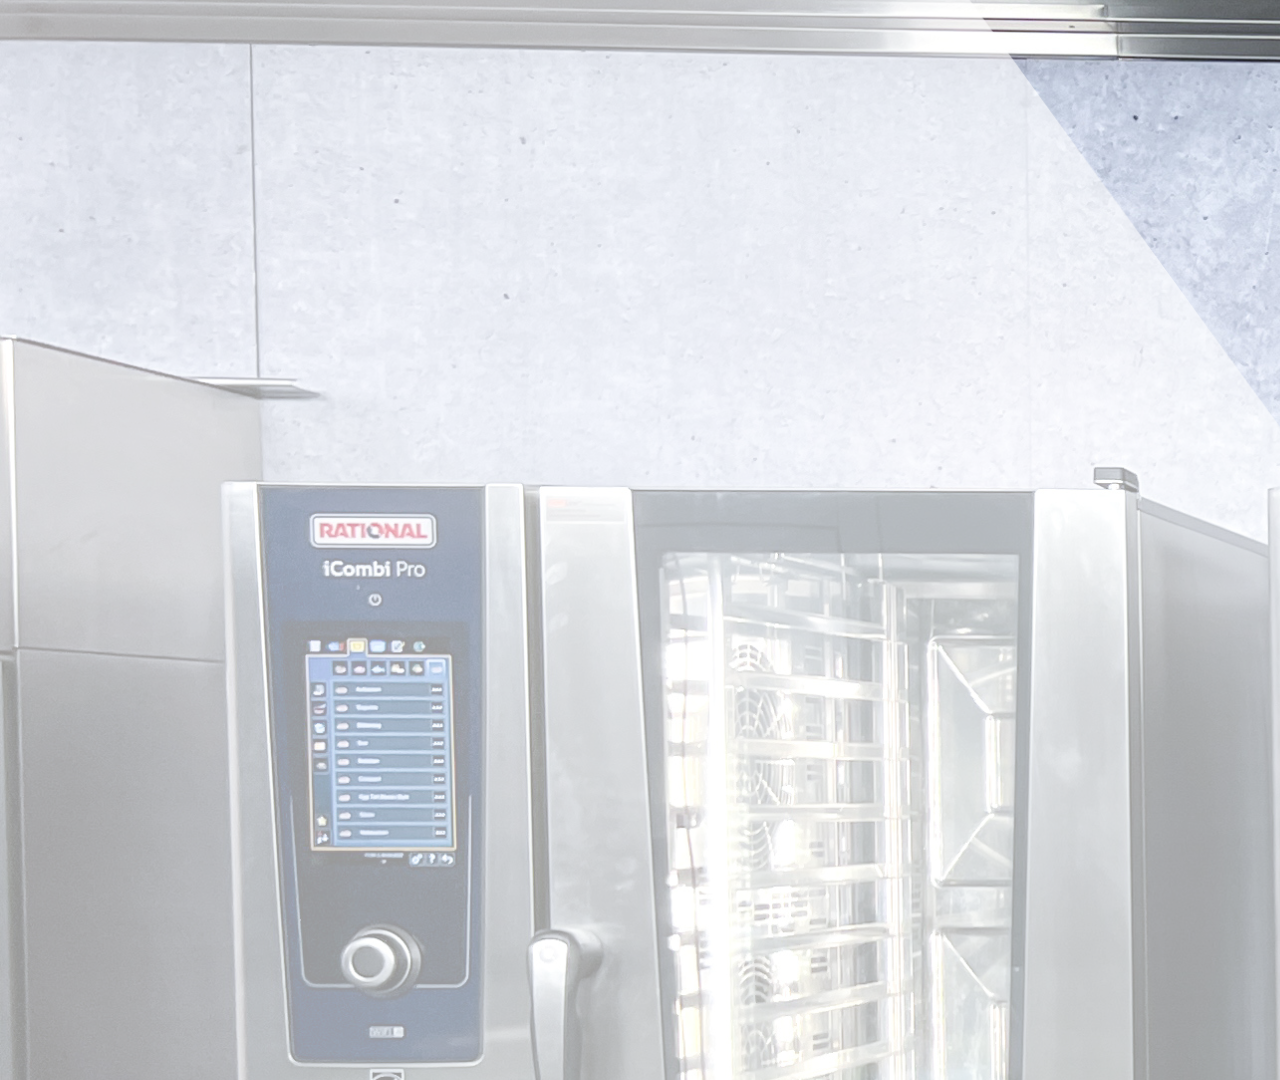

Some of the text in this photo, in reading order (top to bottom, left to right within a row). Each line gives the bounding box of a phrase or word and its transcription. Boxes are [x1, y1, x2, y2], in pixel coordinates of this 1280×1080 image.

[319, 522, 428, 539] RATIONAL
[322, 560, 426, 577] iCombi Pro
